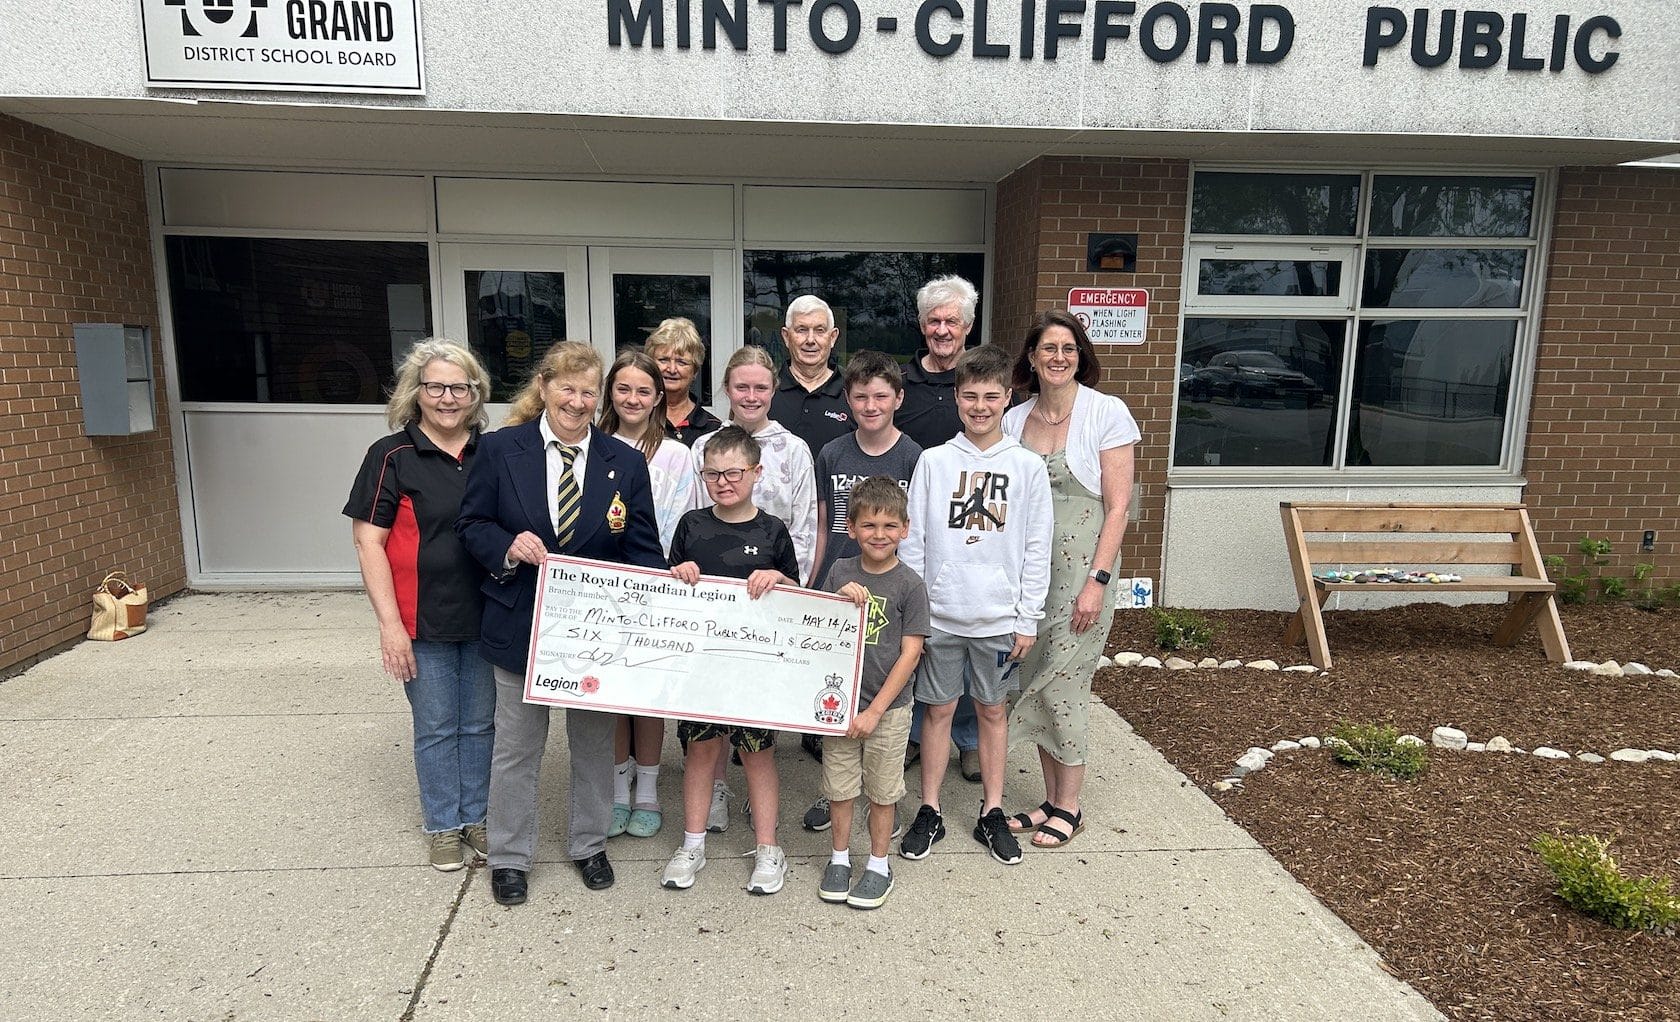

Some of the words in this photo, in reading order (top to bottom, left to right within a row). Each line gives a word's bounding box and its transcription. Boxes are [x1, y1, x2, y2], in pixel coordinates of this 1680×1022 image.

[286, 0, 394, 42] GRAND
[1362, 6, 1622, 74] PUBLIC
[184, 47, 255, 62] DISTRICT
[261, 49, 333, 65] SCHOOL
[338, 51, 397, 66] BOARD
[1080, 292, 1137, 305] EMERGENCY
[1093, 309, 1113, 318] WHEN
[1116, 309, 1137, 318] LIGHT
[1092, 319, 1127, 328] FLASHING
[1091, 329, 1101, 338] DO
[1103, 329, 1117, 338] NOT
[1120, 329, 1142, 338] ENTER
[550, 567, 577, 582] The
[580, 572, 619, 588] Royal
[623, 578, 687, 597] Canadian
[692, 587, 736, 602] Legion
[548, 585, 576, 596] Branch
[577, 591, 608, 601] number
[617, 591, 649, 606] 296
[777, 616, 794, 624] DATE
[801, 614, 826, 628] MAY
[566, 627, 603, 642] SIX
[618, 631, 696, 654] THOUSAND
[783, 656, 810, 666] DOLLARS
[535, 674, 579, 691] Legion
